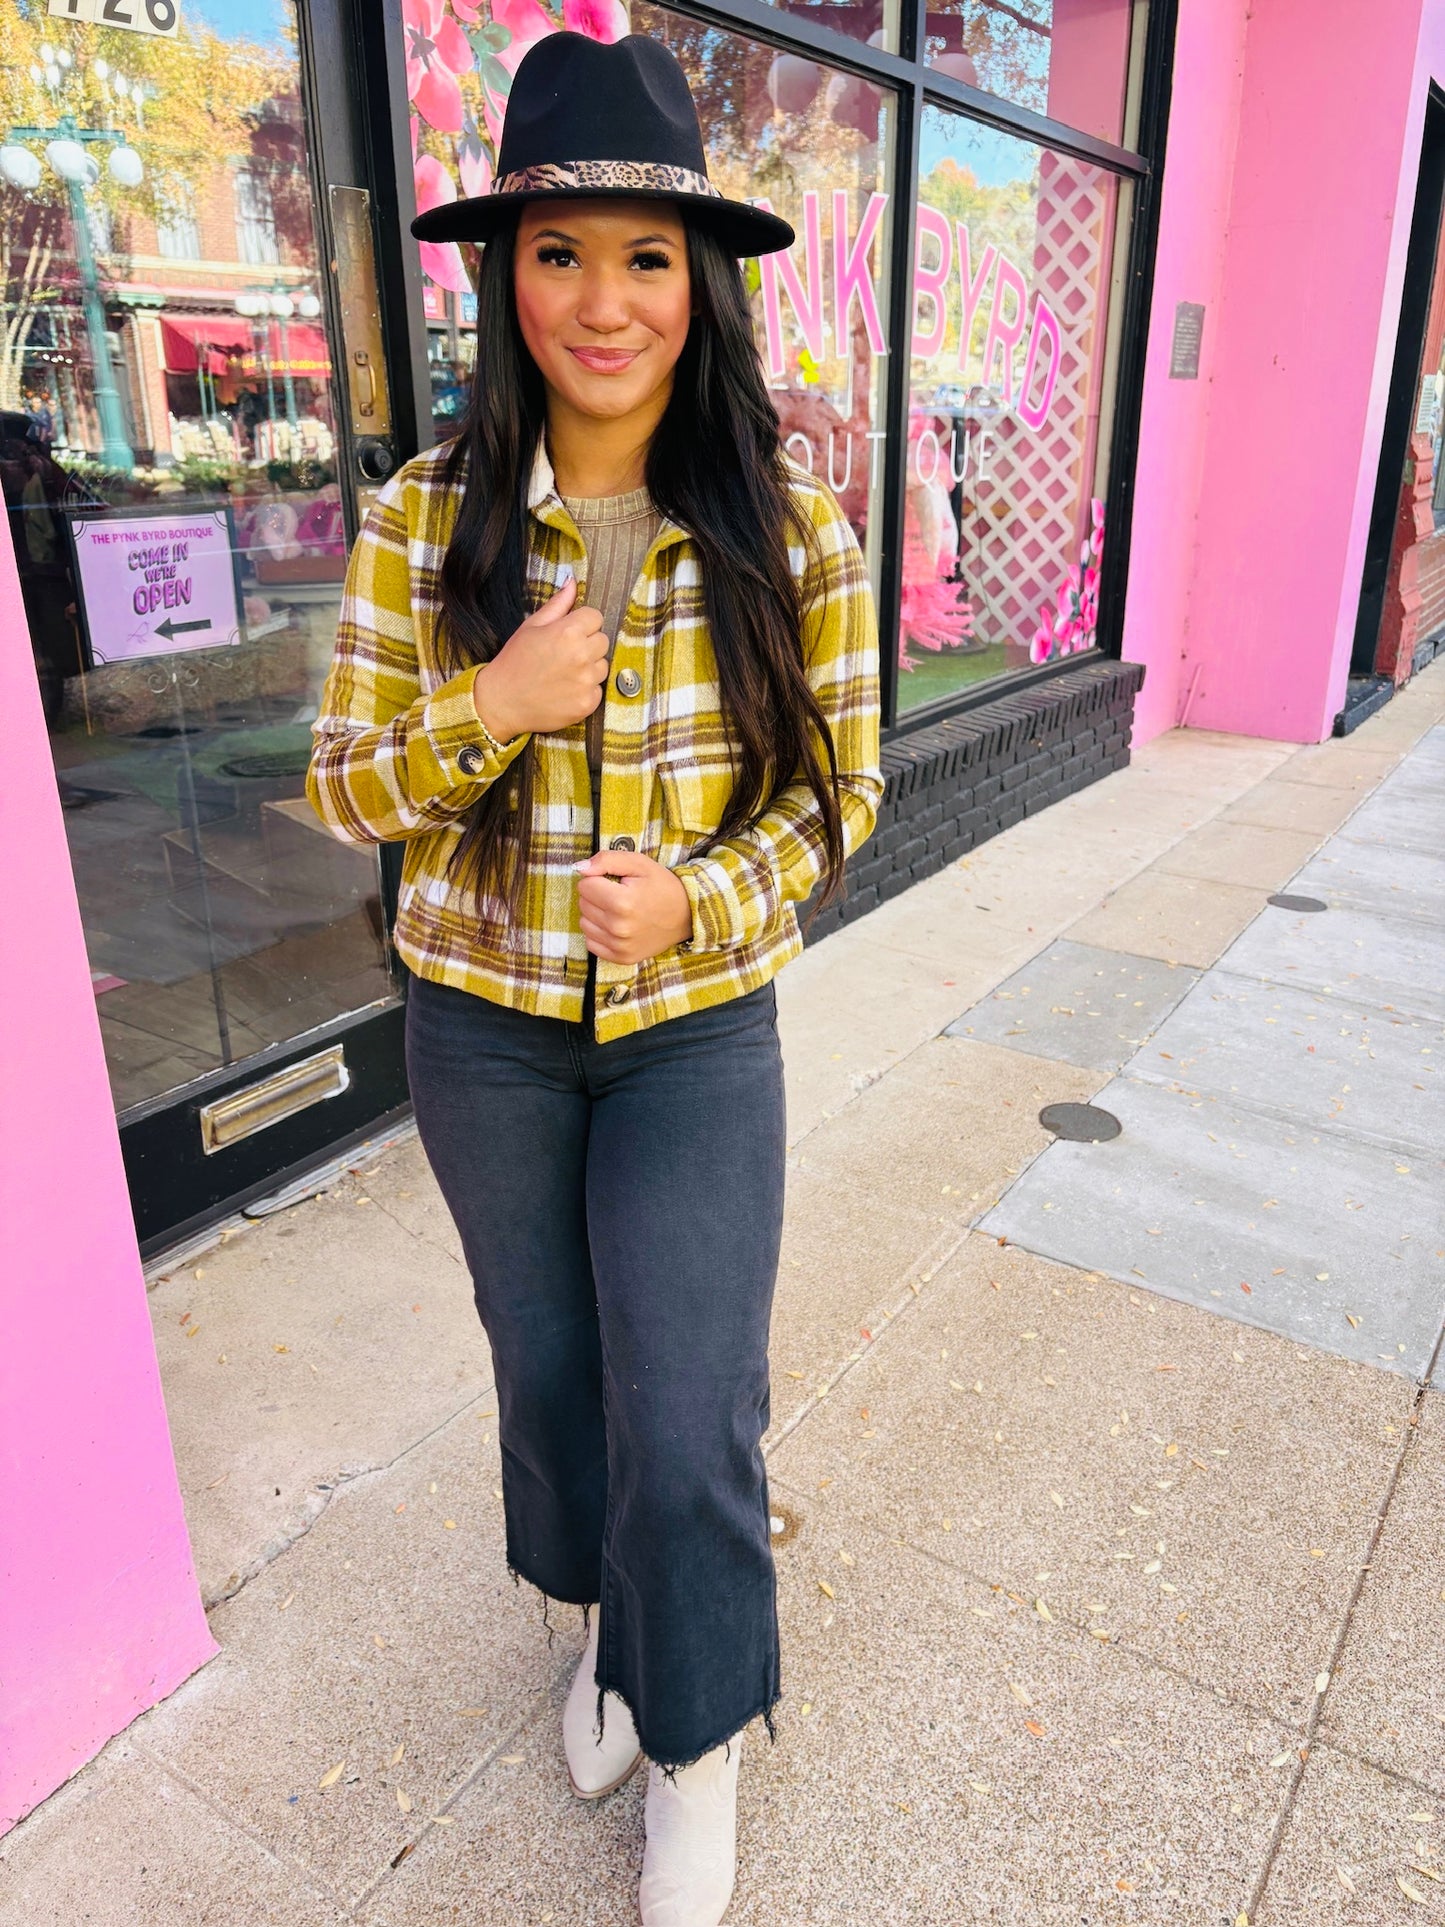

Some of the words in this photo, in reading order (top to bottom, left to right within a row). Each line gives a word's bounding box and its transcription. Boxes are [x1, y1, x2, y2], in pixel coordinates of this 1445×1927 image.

[744, 189, 890, 379] NK
[911, 201, 1062, 433] BYRD
[91, 534, 110, 545] THE
[112, 531, 140, 543] PYNK
[142, 530, 167, 541] BYRD
[169, 527, 213, 539] BOUTIQUE
[128, 545, 169, 571] COME
[172, 542, 189, 562] IN
[133, 577, 192, 615] OPEN
